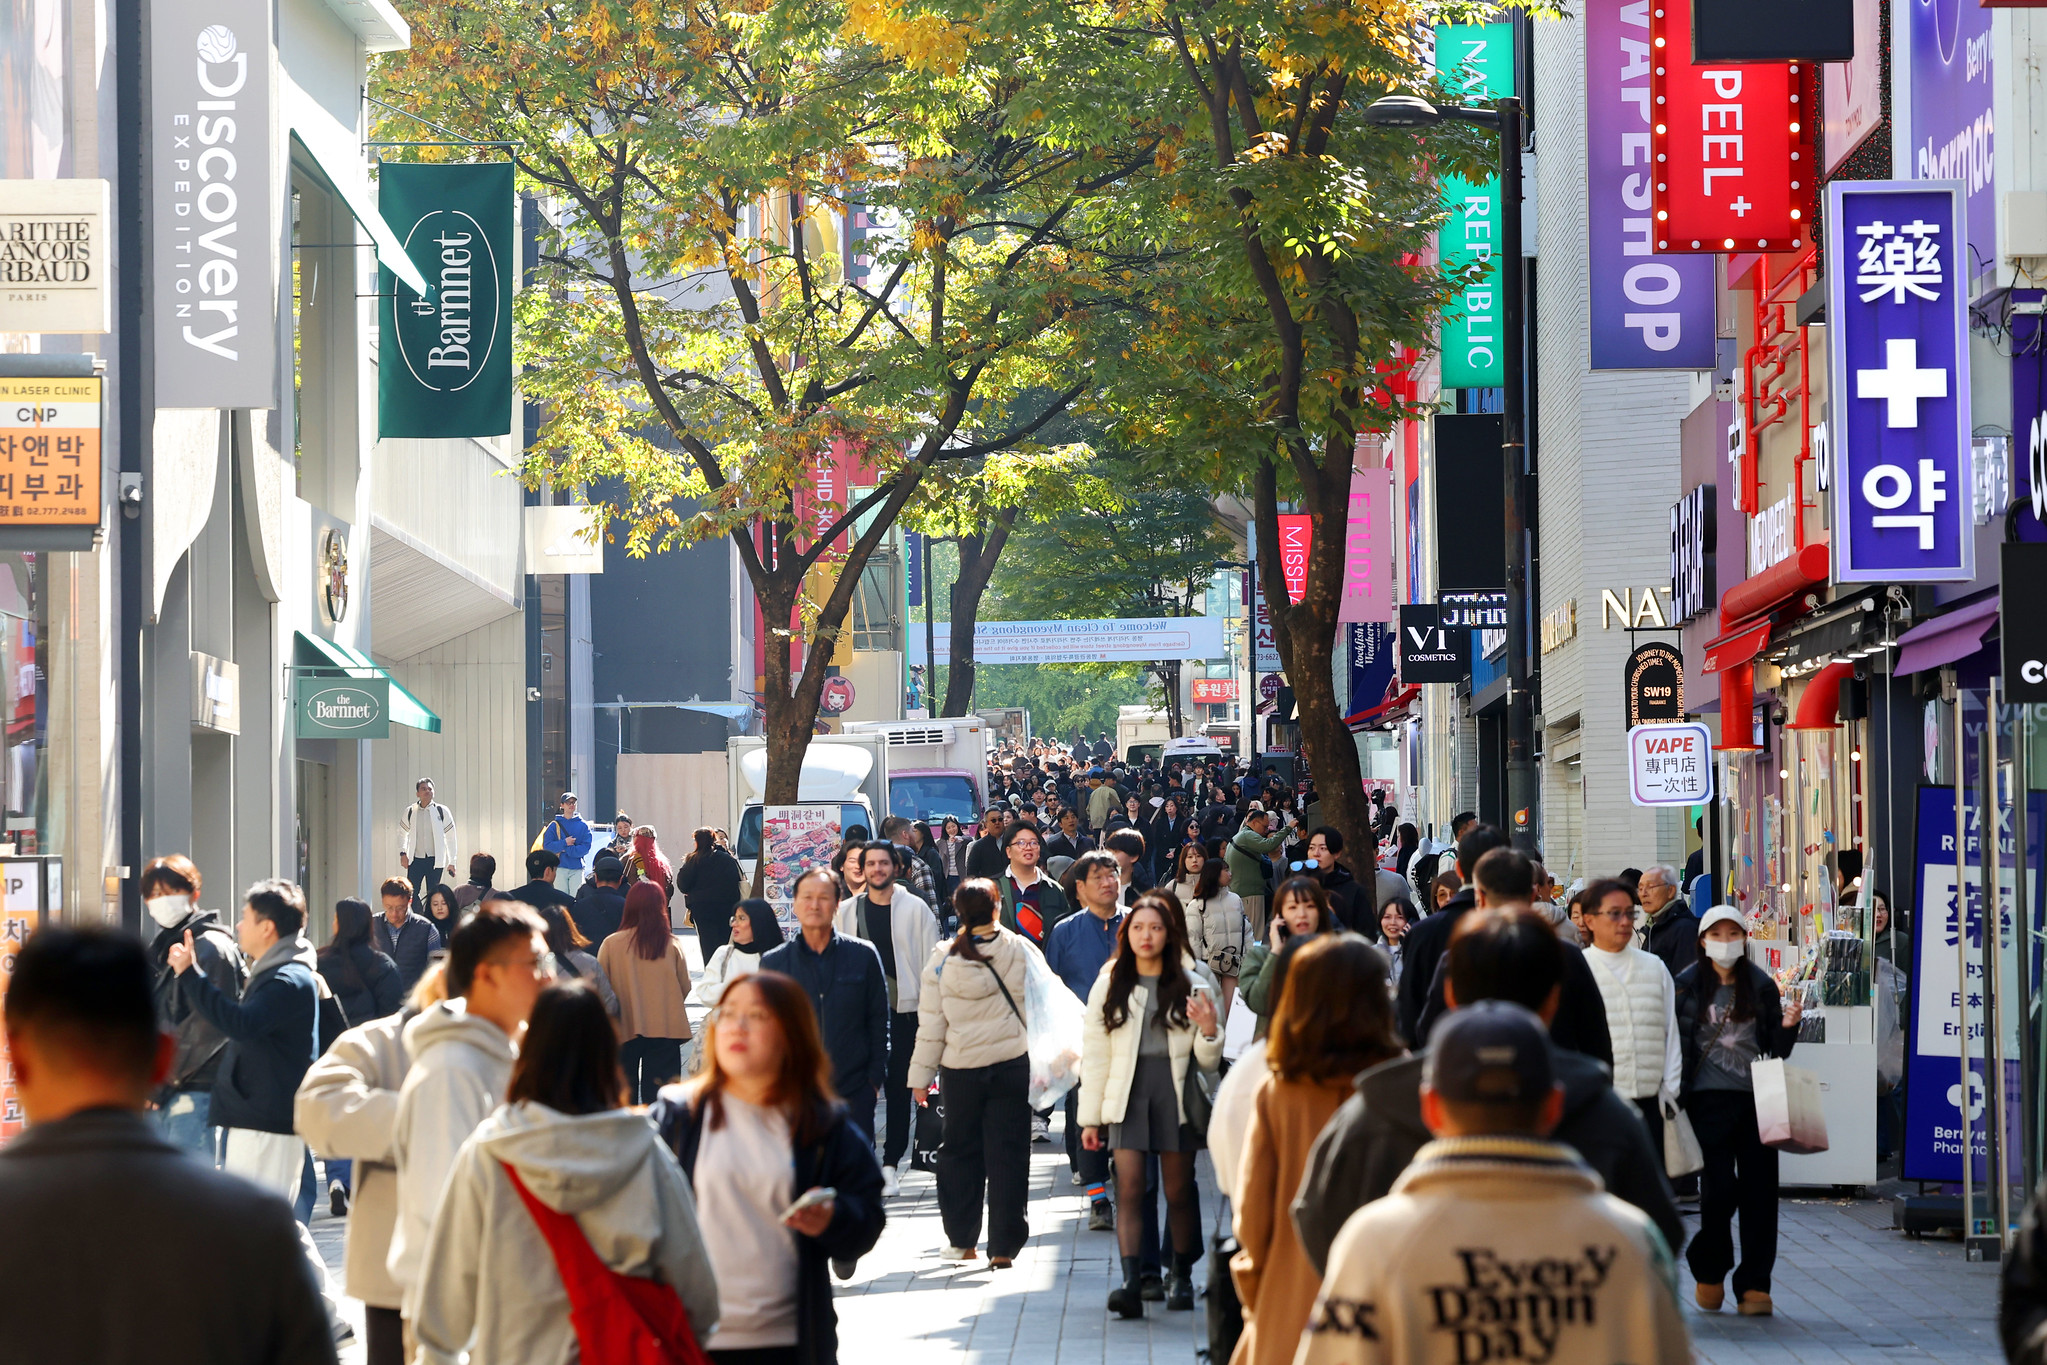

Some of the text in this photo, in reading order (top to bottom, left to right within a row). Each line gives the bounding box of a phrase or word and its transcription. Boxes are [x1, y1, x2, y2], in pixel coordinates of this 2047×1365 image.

[174, 114, 191, 317] EXPEDITION
[1856, 220, 1943, 304] 藥
[411, 284, 435, 316] th
[428, 230, 472, 371] Barnnet
[14, 386, 50, 395] LASER
[55, 386, 91, 395] CLINIC
[17, 408, 57, 422] CNP
[1862, 459, 1947, 550] 약
[1348, 493, 1371, 598] ETUDE
[1602, 587, 1671, 629] NA
[1355, 628, 1366, 669] Rockfish
[1408, 653, 1456, 662] COSMETICS
[1636, 649, 1658, 663] JOURNEY
[337, 694, 350, 704] the
[1643, 686, 1671, 697] SW19
[316, 700, 371, 718] Barnnet
[1645, 737, 1694, 754] VAPE
[1645, 756, 1696, 774] 專門店
[1646, 776, 1698, 793] 一次性
[1456, 1245, 1617, 1290] Every
[1427, 1284, 1598, 1329] Damn
[1452, 1327, 1559, 1365] Day
